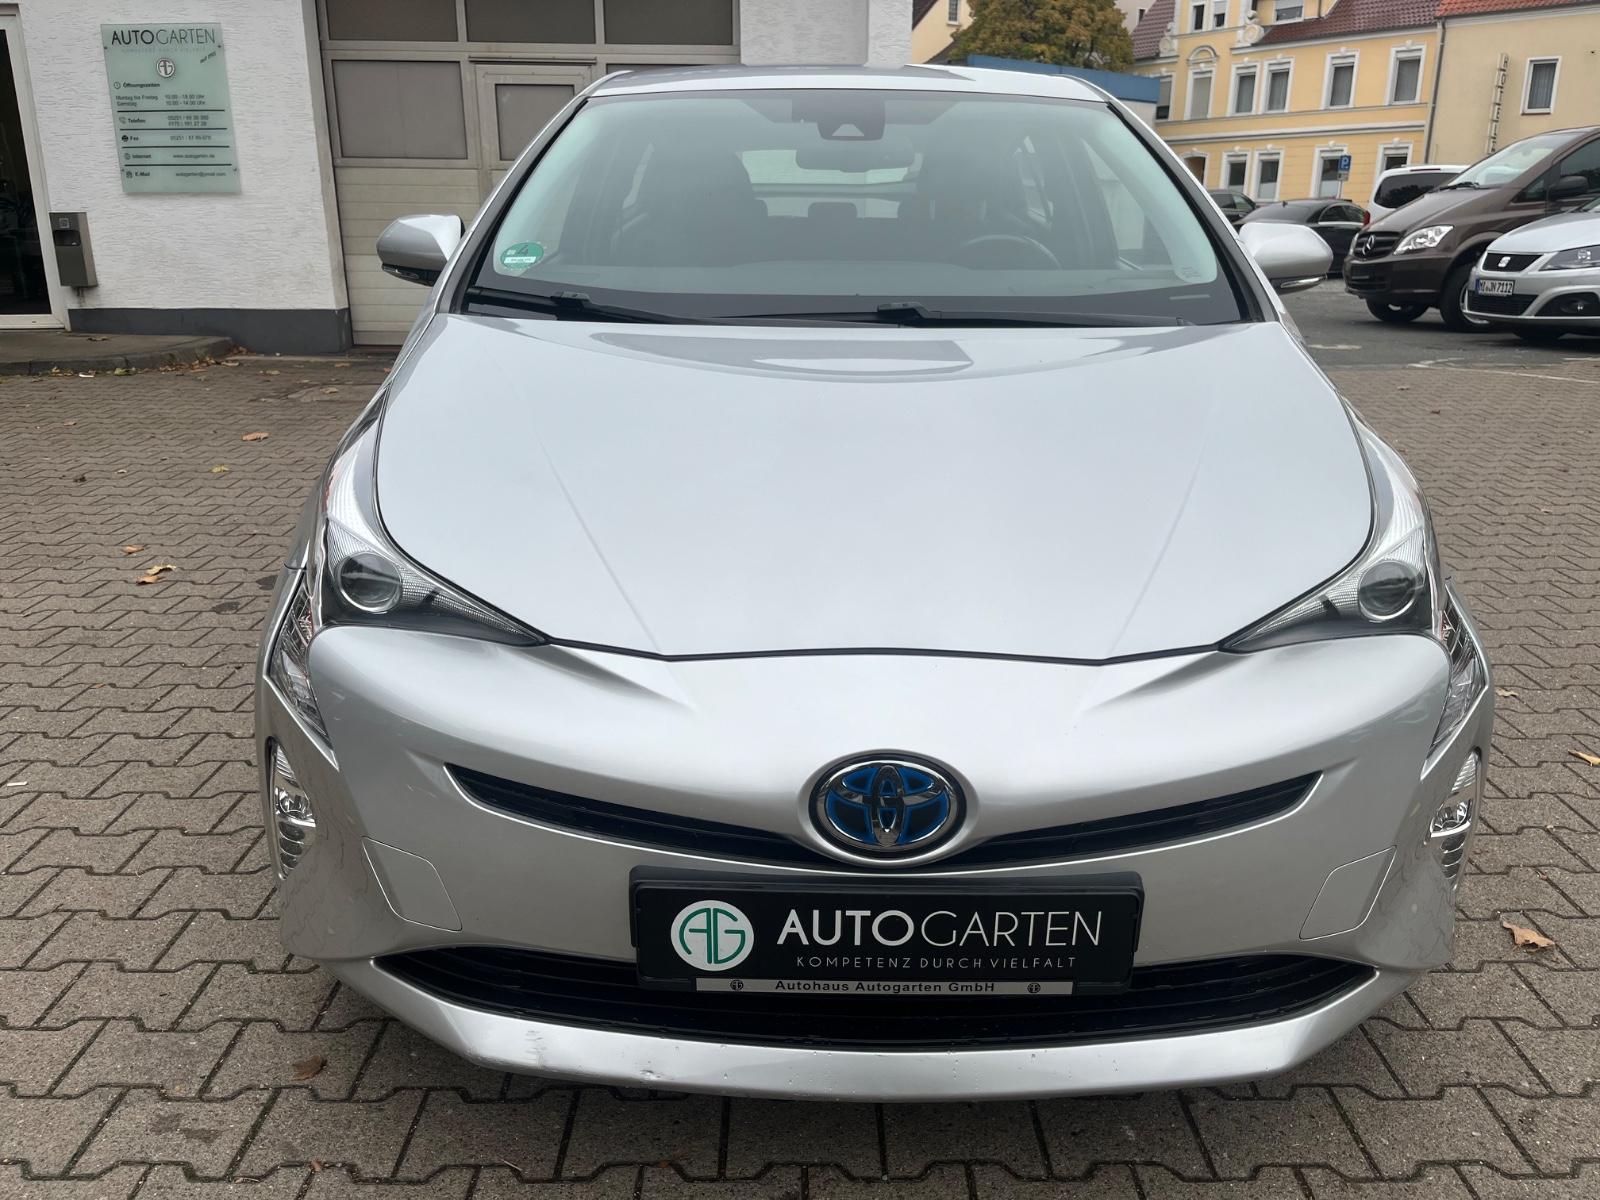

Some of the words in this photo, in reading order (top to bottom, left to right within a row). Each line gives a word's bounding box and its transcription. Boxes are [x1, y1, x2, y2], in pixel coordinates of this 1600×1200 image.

[111, 28, 216, 45] AUTOGARTEN
[1340, 156, 1349, 169] P
[776, 908, 1103, 947] AUTOGARTEN
[796, 956, 911, 969] KOMPETENZ
[920, 957, 982, 969] DURCH
[990, 957, 1077, 969] VIELFALT
[775, 980, 849, 991] Autohaus
[855, 981, 942, 994] Autogarten
[948, 983, 995, 993] GmbH
